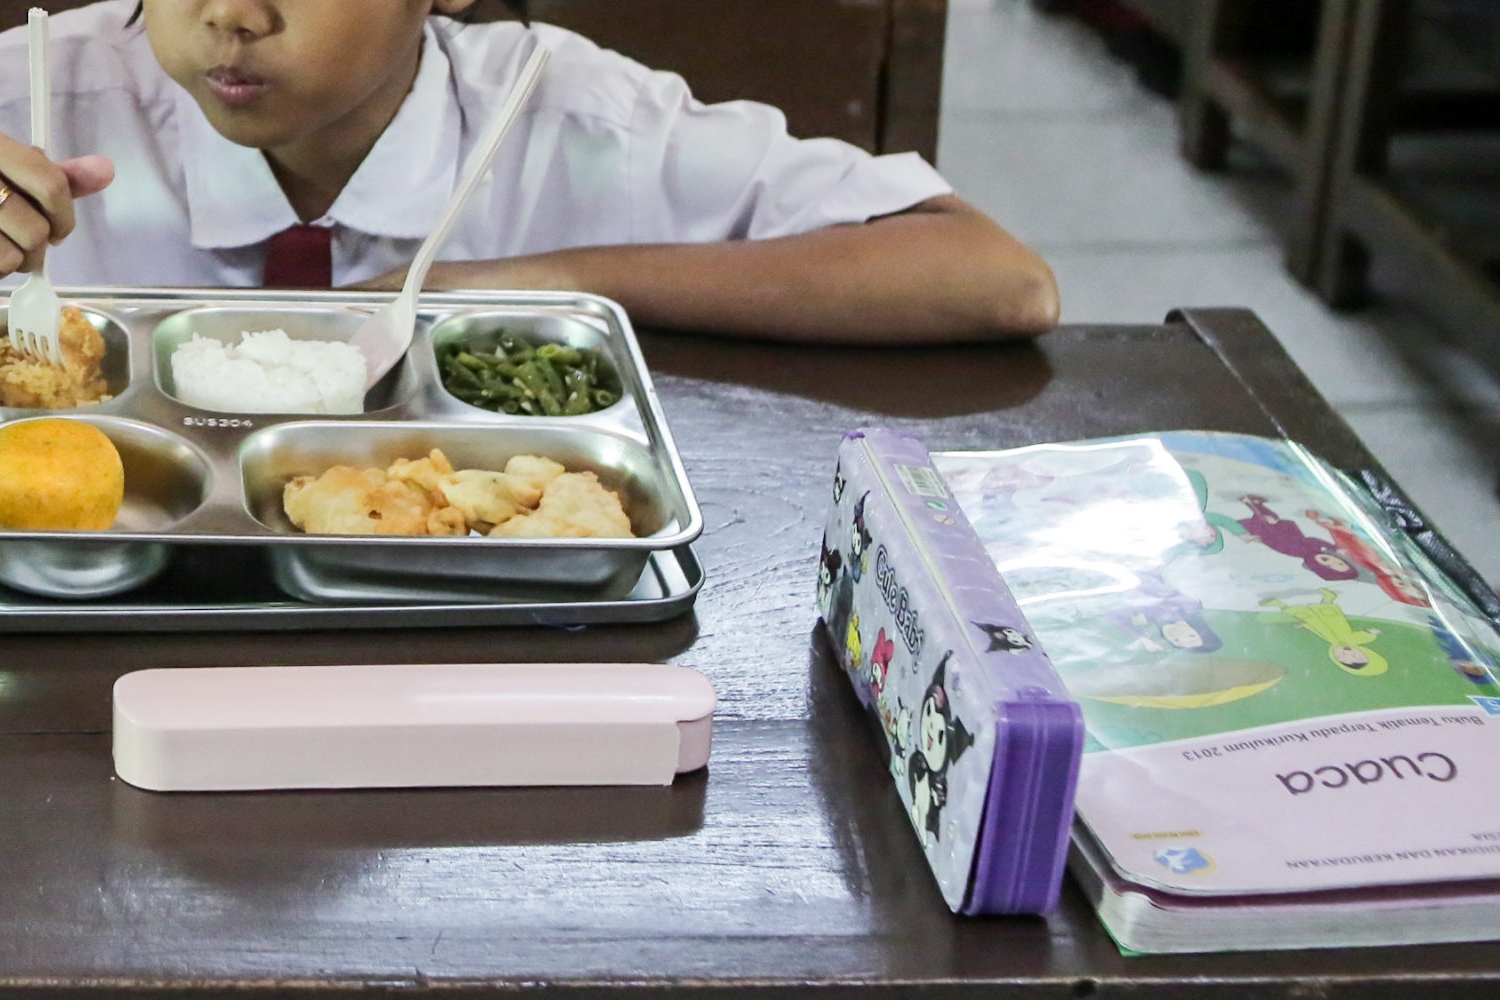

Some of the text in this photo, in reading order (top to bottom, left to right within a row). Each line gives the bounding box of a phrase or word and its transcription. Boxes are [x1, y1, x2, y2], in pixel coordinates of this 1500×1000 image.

[182, 416, 254, 428] SUS304
[875, 543, 925, 675] Cute Baby
[1181, 715, 1485, 761] Buku Tematik Terpadu Kurikulum 2013
[1276, 751, 1459, 795] Cuaca
[1285, 852, 1393, 870] KEBUDAYAAN
[1395, 850, 1431, 861] DAN
